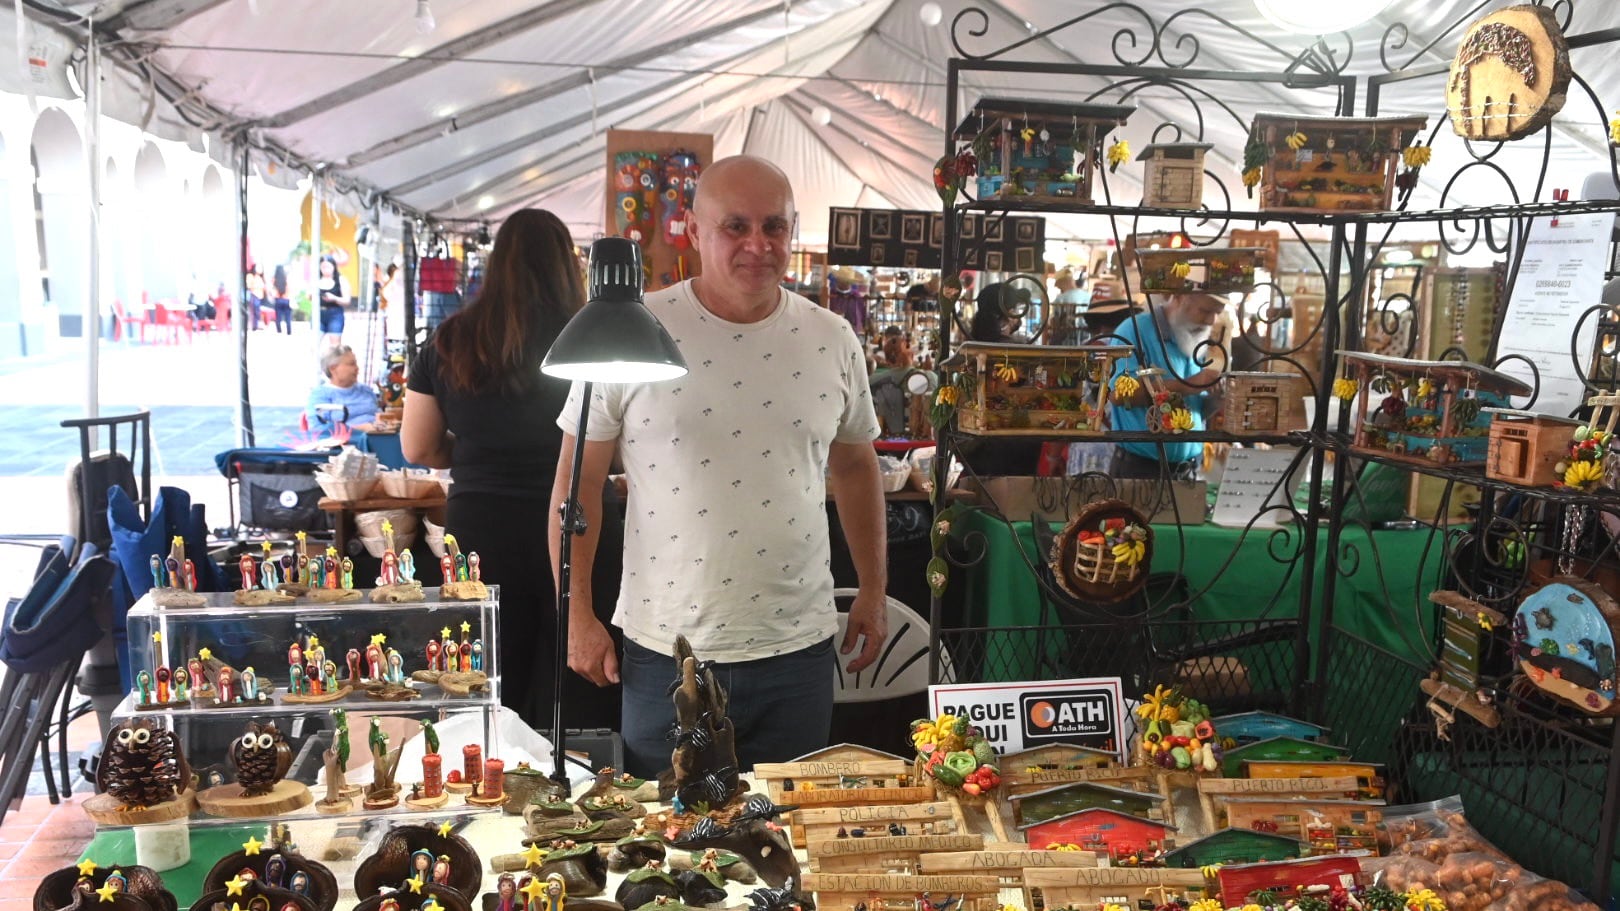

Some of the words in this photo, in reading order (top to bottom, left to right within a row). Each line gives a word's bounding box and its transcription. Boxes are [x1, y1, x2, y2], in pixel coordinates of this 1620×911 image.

[943, 703, 1015, 722] PAGUE
[1058, 701, 1105, 723] ATH
[799, 762, 861, 776] BOMBERO
[1232, 779, 1285, 792] PUERTO
[839, 806, 909, 821] POLICIA
[822, 837, 913, 854] CONSULTORIO
[918, 836, 971, 849] MEDICO
[819, 876, 891, 890] ESTACION
[896, 877, 911, 890] DE
[916, 877, 983, 891] BOMBEROS
